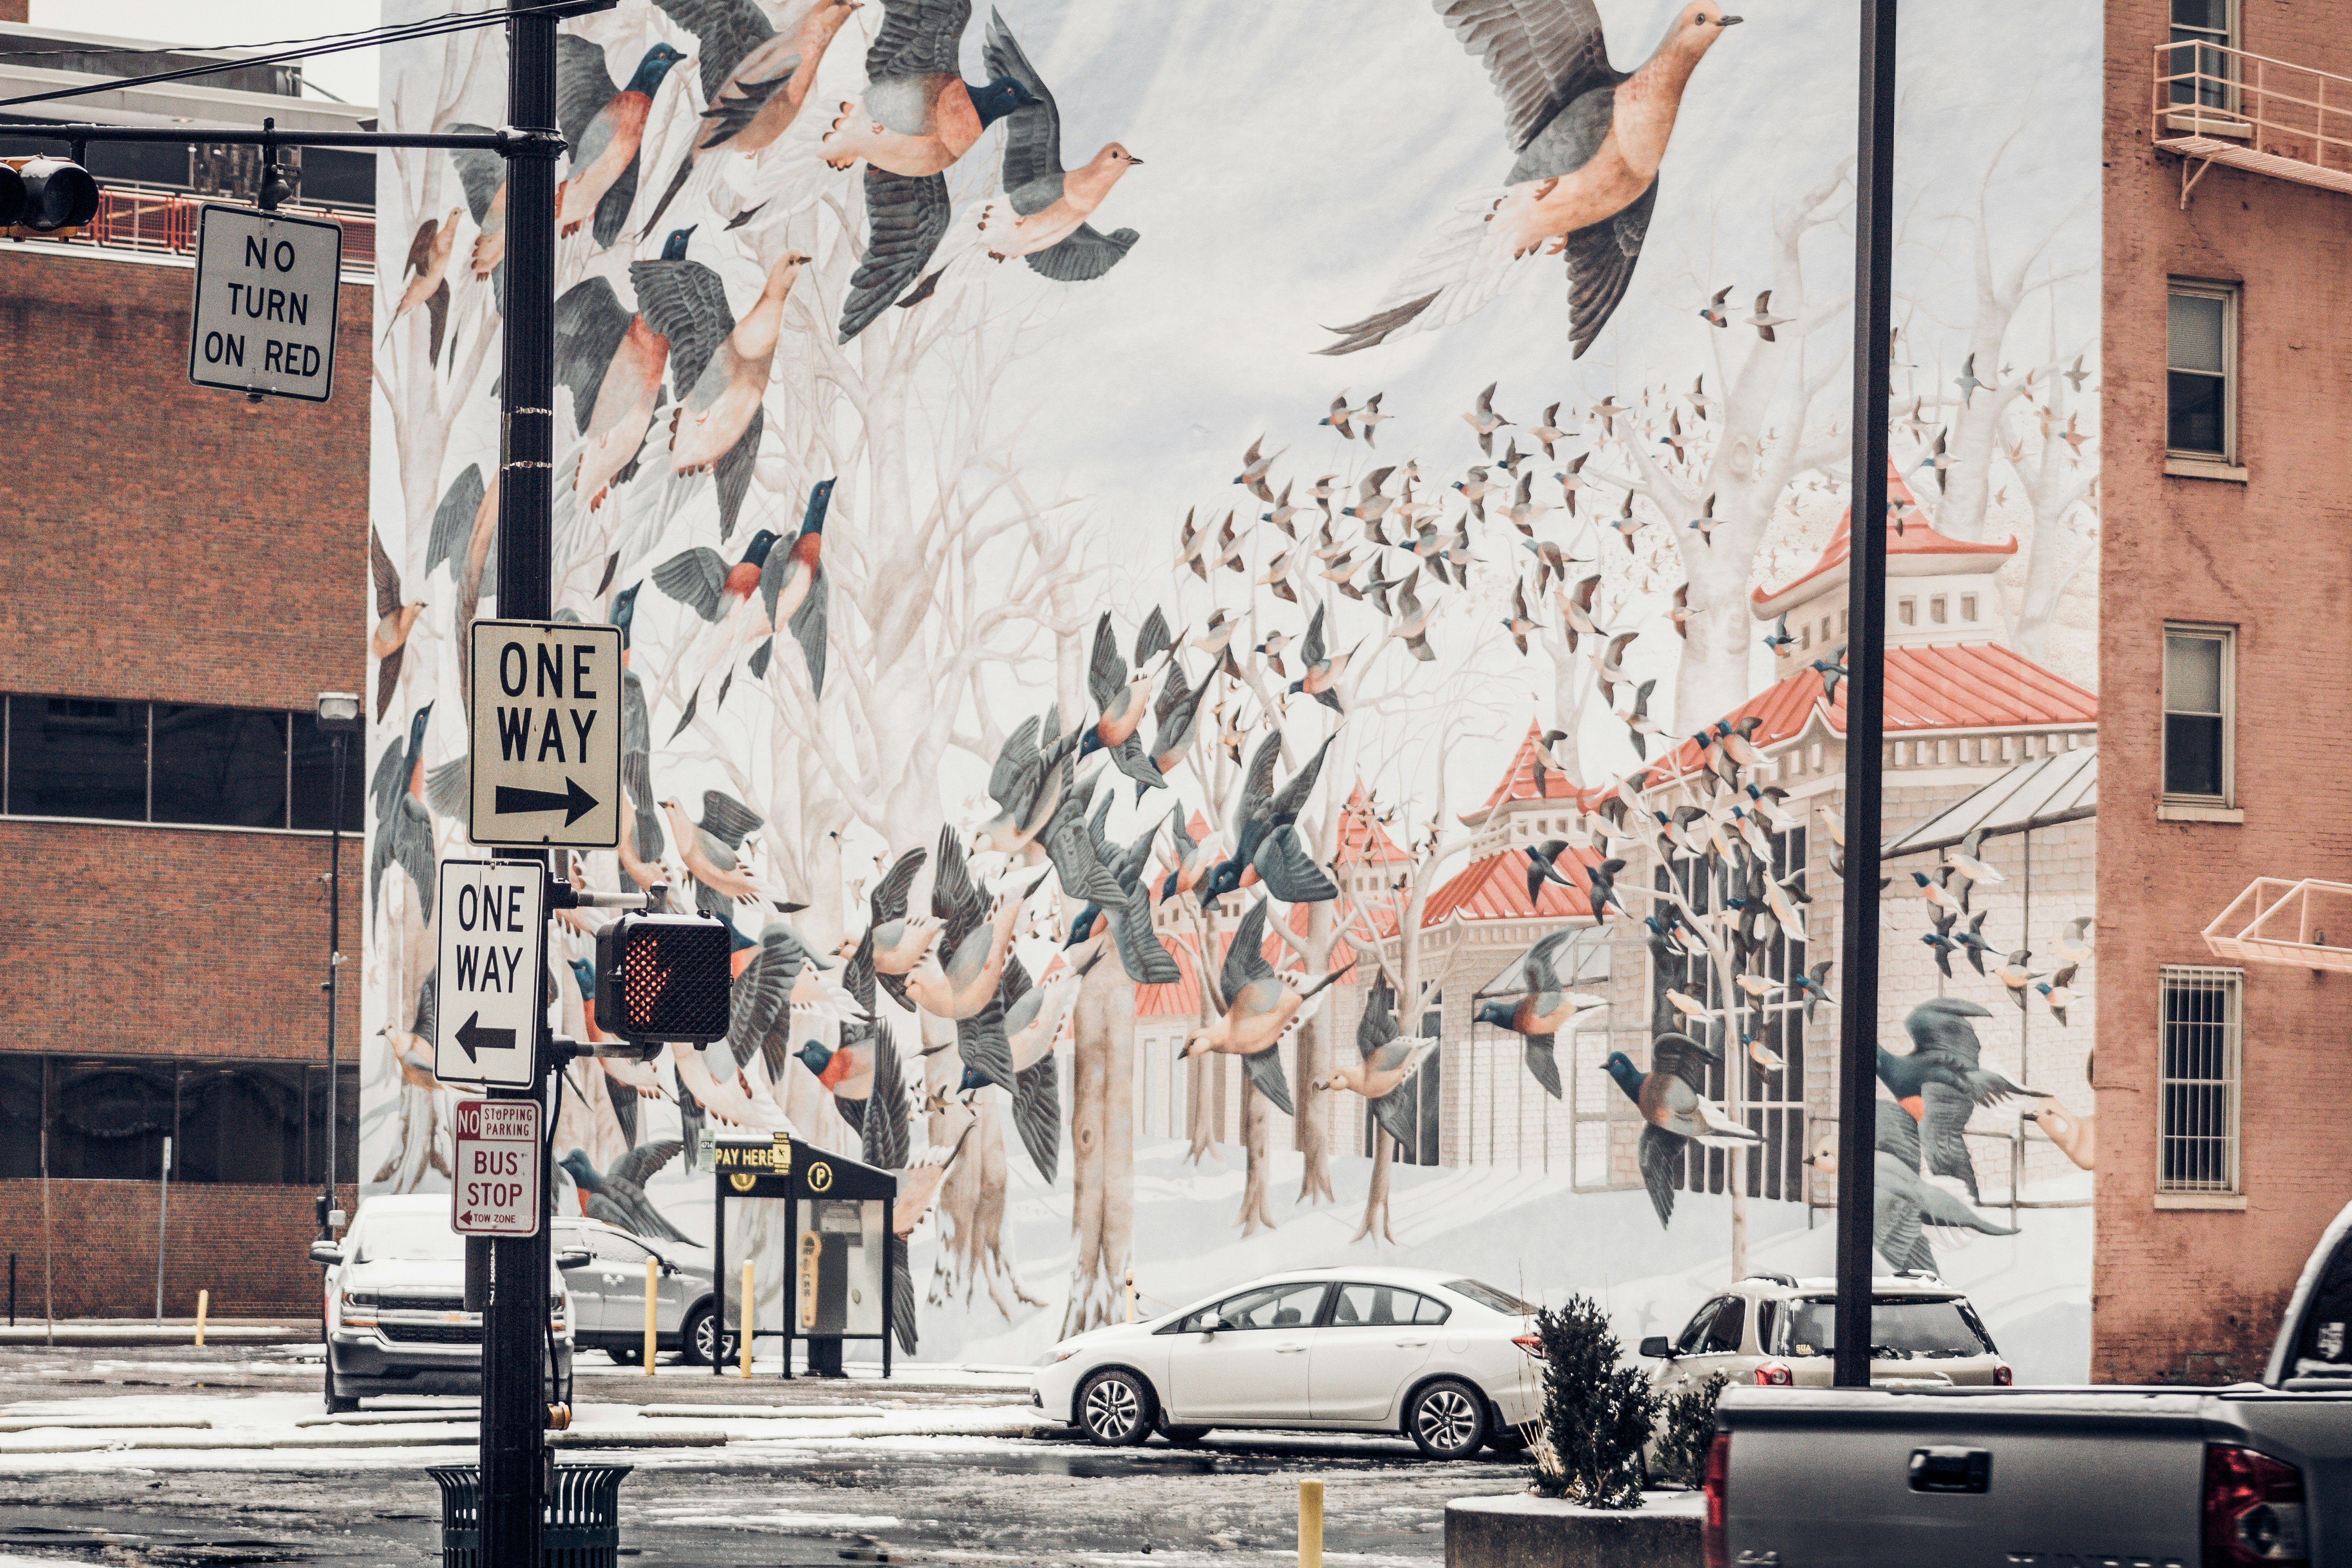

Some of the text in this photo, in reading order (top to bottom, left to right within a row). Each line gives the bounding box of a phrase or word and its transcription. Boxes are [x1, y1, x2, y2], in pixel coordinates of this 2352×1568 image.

[245, 235, 295, 273] NO
[228, 282, 308, 326] TURN
[205, 331, 320, 377] ON RED
[500, 642, 597, 699] ONE
[496, 706, 598, 764] WAY
[459, 883, 525, 933] ONE
[456, 944, 524, 993] WAY
[458, 1109, 480, 1134] NO
[484, 1108, 533, 1121] STOPPING
[486, 1123, 529, 1136] PARKING
[474, 1150, 518, 1175] BUS
[715, 1148, 739, 1166] PAY
[742, 1149, 774, 1167] HERE
[816, 1167, 826, 1186] P
[467, 1182, 522, 1207] STOP
[473, 1213, 516, 1223] TOW ZONE
